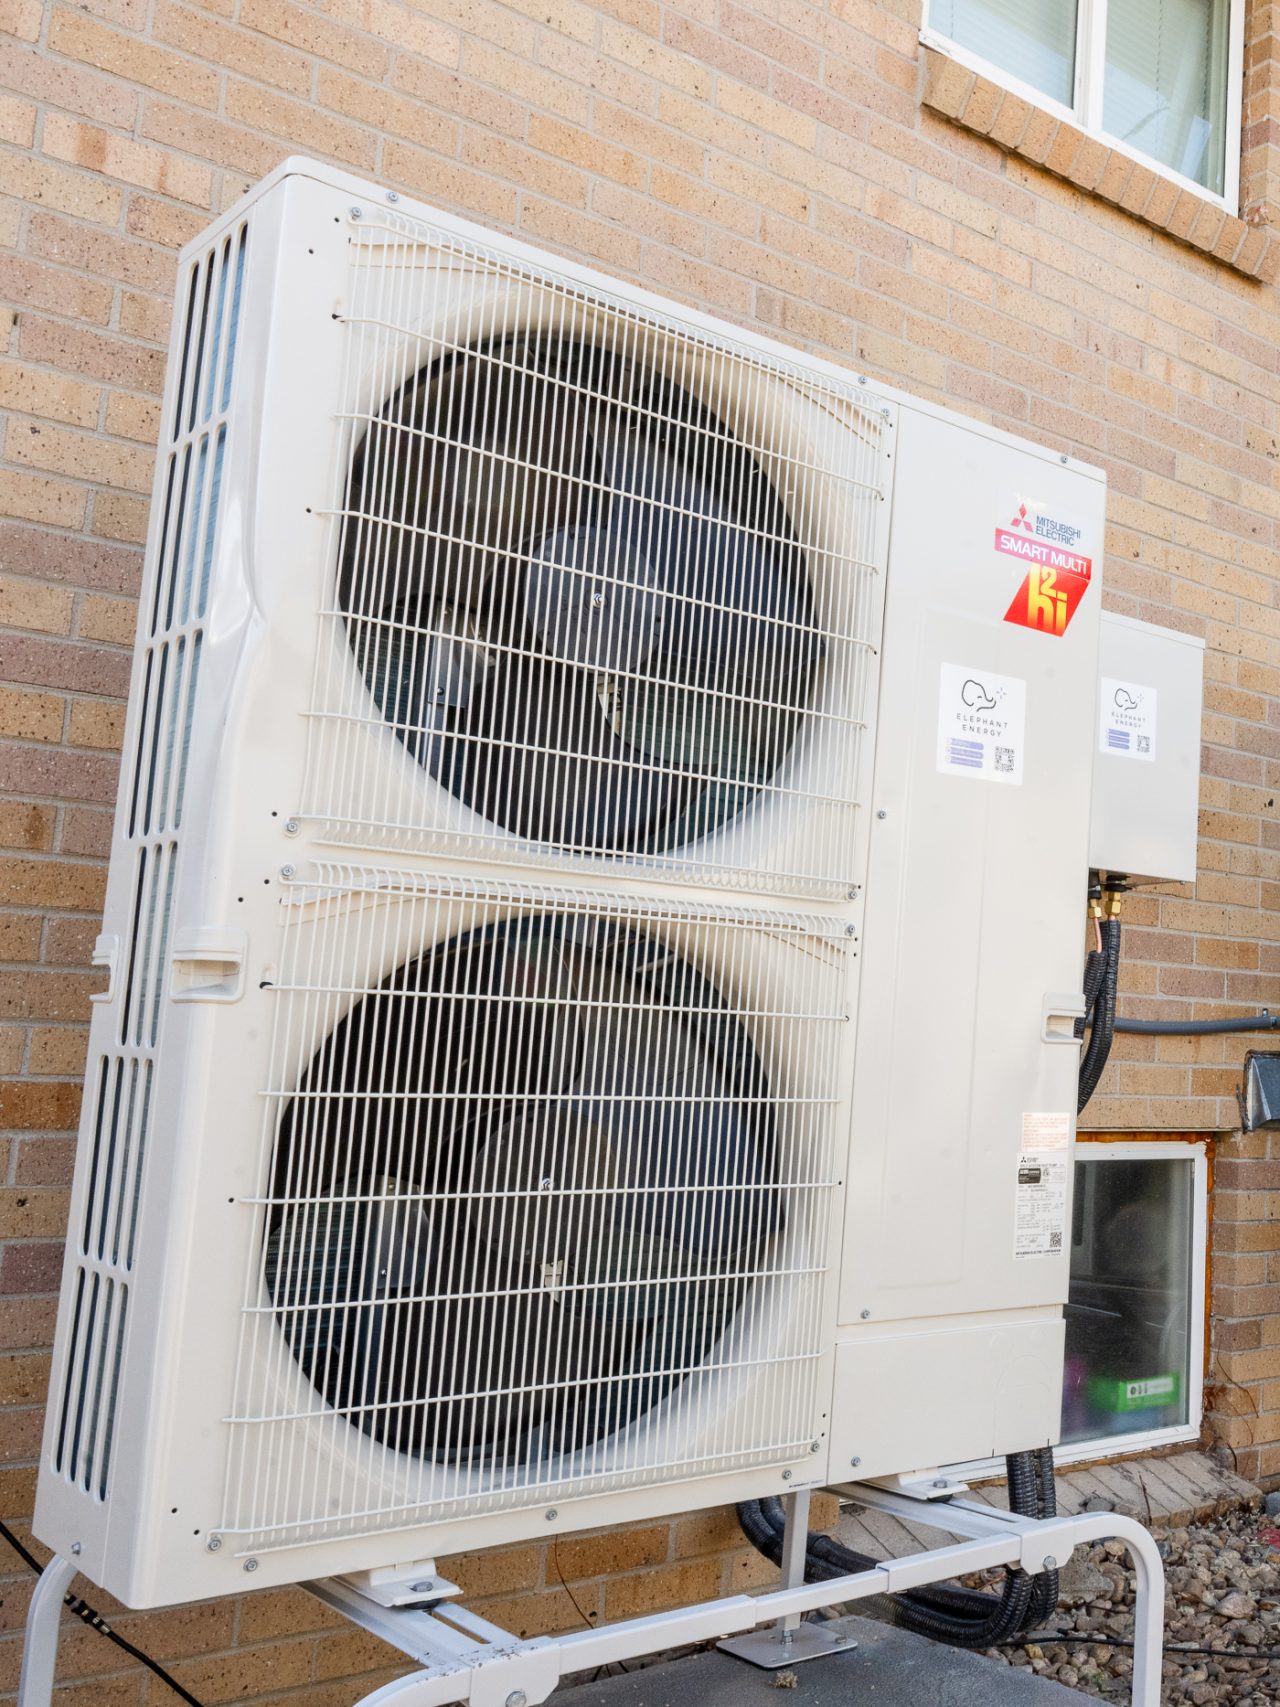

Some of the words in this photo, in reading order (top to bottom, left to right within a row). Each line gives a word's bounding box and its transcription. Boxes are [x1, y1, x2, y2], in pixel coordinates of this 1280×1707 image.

[1036, 515, 1081, 539] MITSUBISHI
[1036, 526, 1075, 546] ELECTRIC
[1000, 535, 1049, 561] SMART
[1050, 551, 1087, 574] MULTI
[956, 713, 1008, 728] ELEPHANT
[962, 724, 1002, 736] ENERGY
